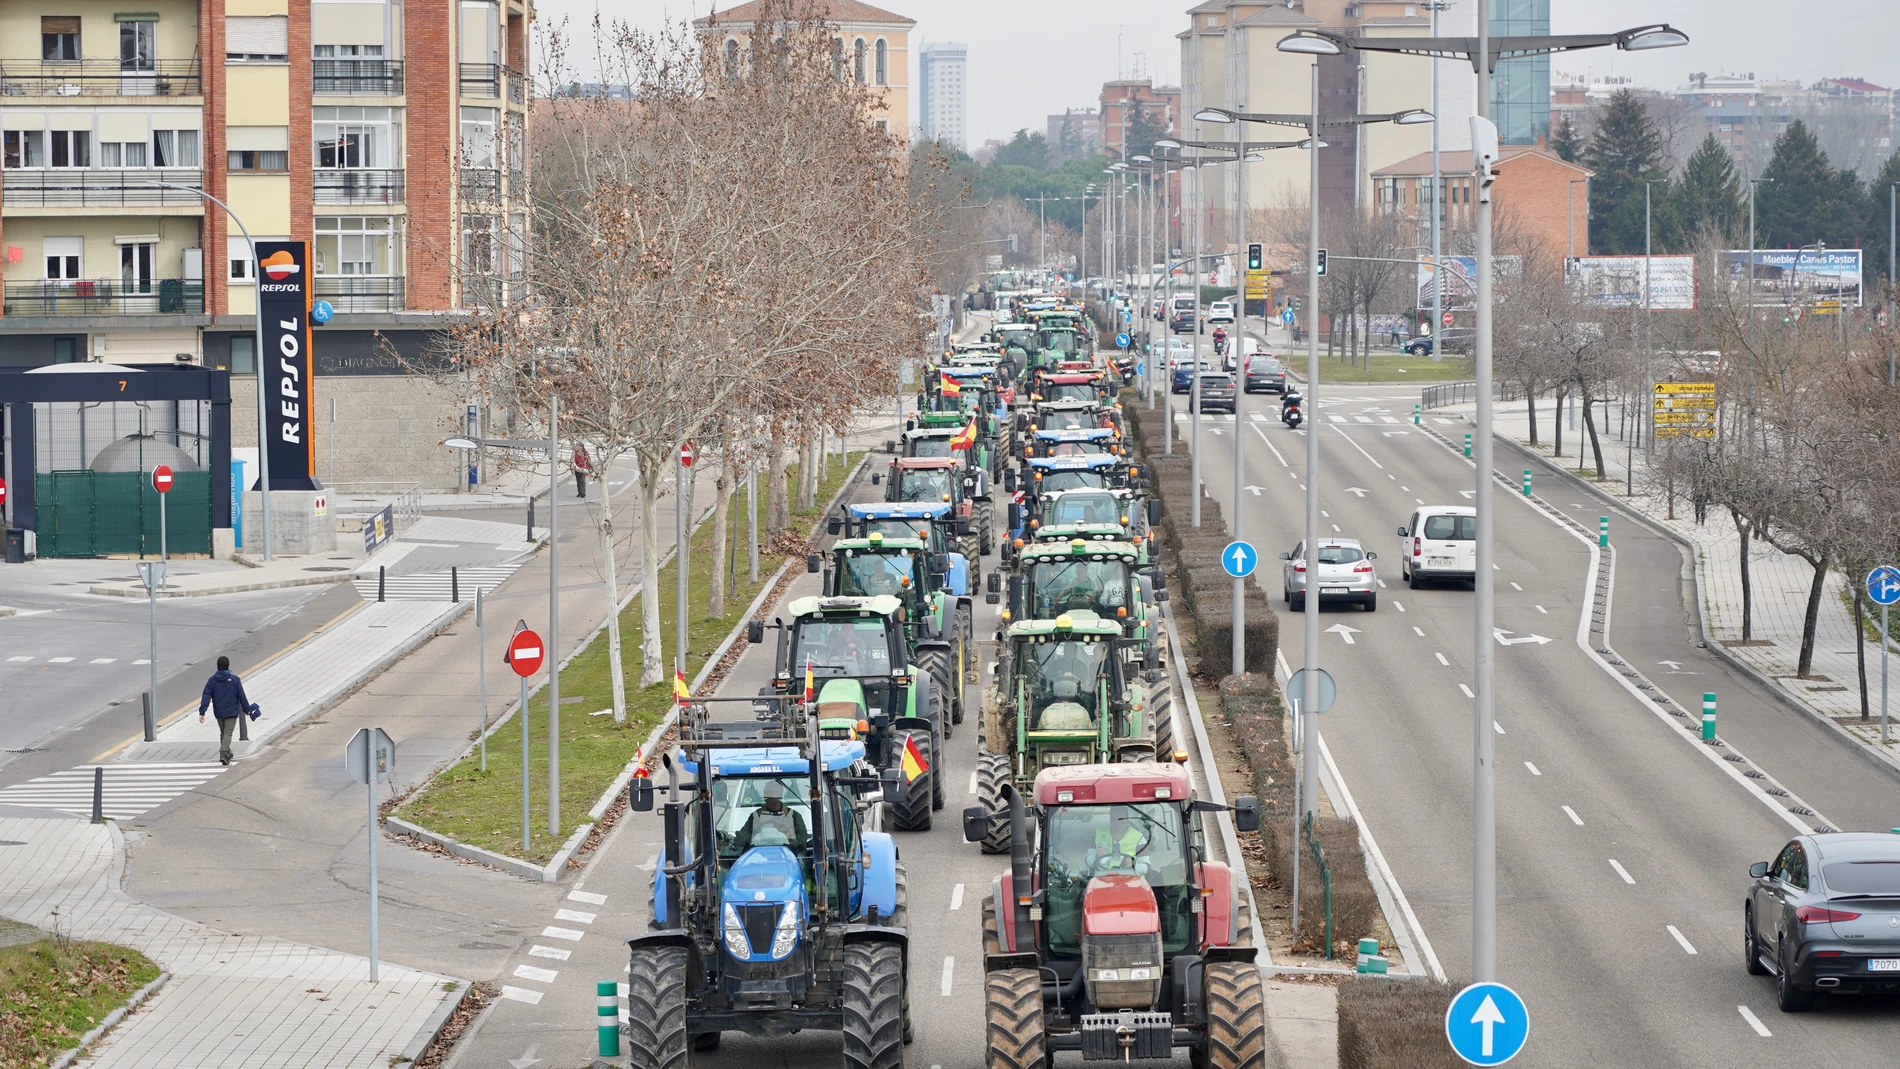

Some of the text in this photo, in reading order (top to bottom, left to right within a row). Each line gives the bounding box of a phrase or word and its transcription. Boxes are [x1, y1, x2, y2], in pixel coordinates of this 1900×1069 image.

[1829, 254, 1857, 264] Pastor
[261, 284, 301, 292] REPSOL
[280, 317, 300, 444] REPSOL
[118, 380, 127, 392] 7
[1875, 961, 1897, 969] 7070
